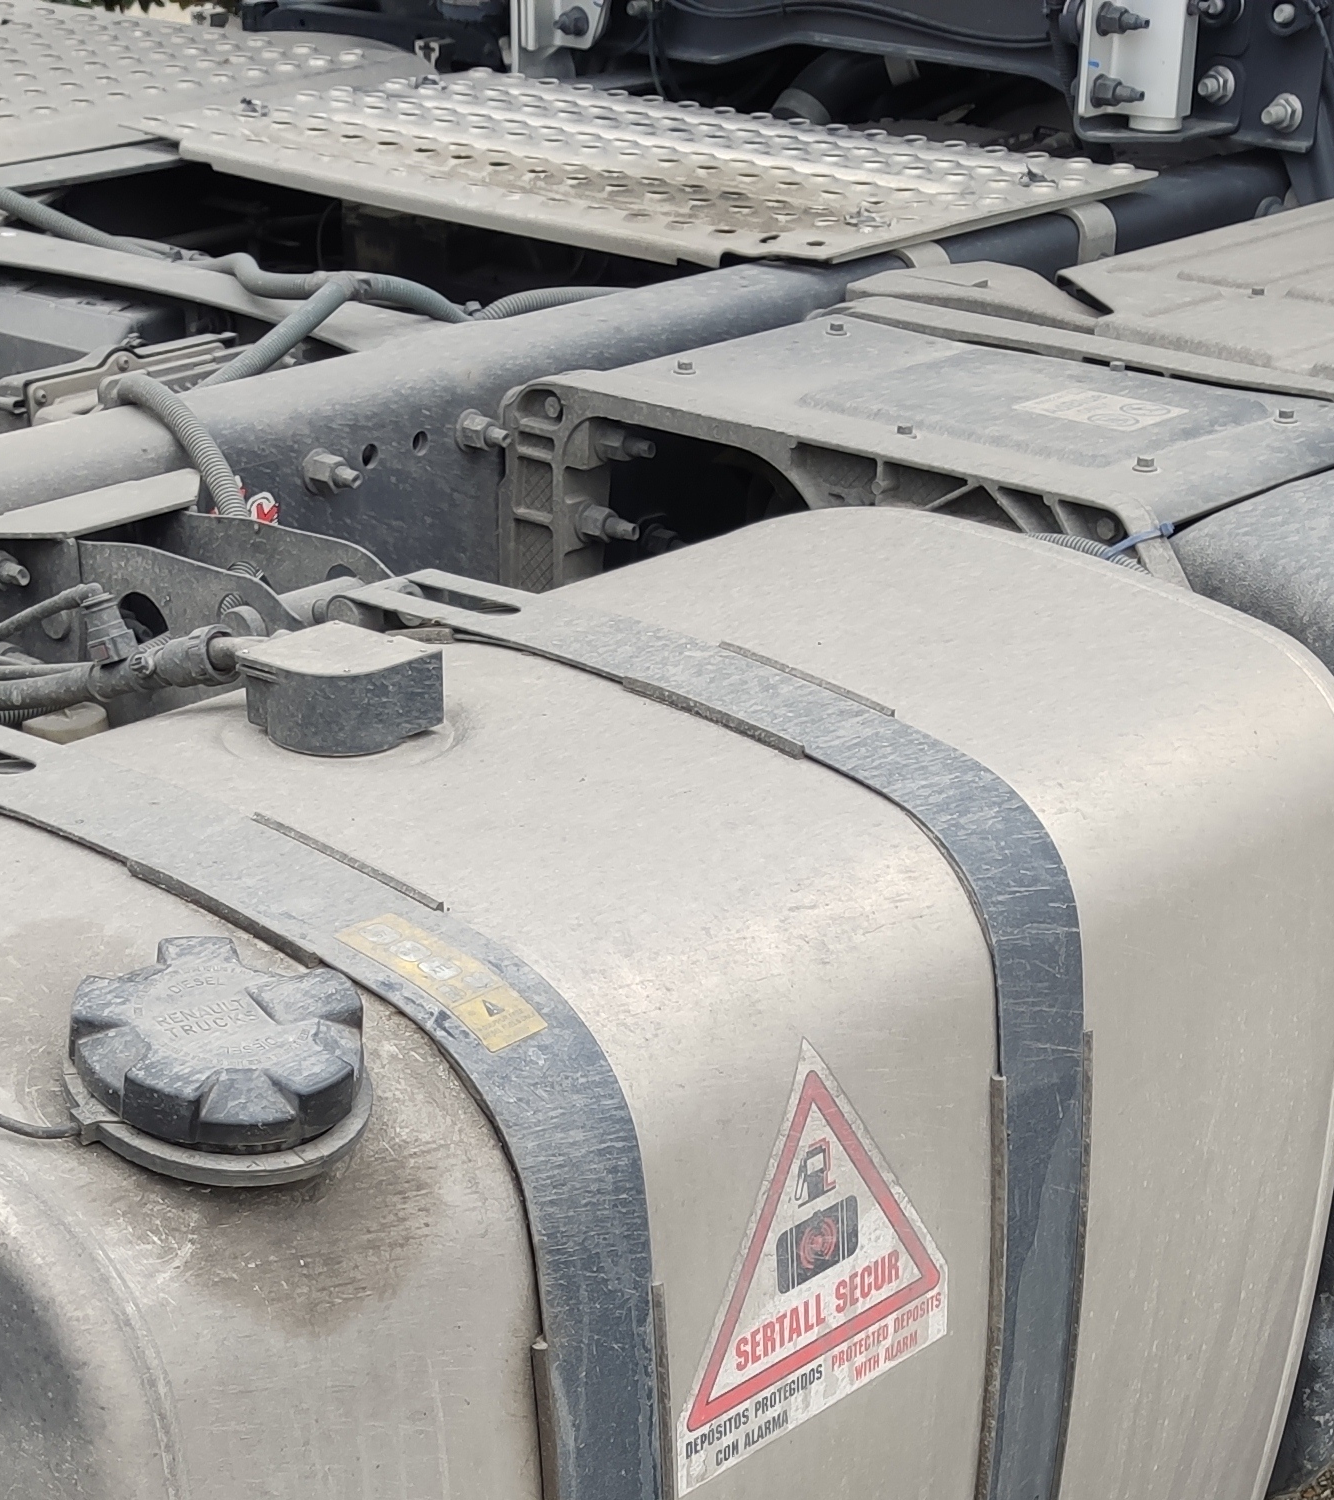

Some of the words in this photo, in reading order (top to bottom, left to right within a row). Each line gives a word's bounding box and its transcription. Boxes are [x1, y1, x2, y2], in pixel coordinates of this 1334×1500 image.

[168, 976, 226, 994] DIESEL
[152, 999, 247, 1027] RENAULT
[164, 1010, 259, 1039] TRUCKS
[219, 1037, 278, 1055] DIESEL
[735, 1293, 826, 1371] SERTALL
[834, 1249, 900, 1314] SECUR
[831, 1323, 889, 1372] PROTECTED
[893, 1292, 942, 1334] DEPOSITS
[854, 1354, 880, 1382] WITH
[883, 1330, 918, 1365] ALARM
[685, 1408, 750, 1460] DEPÓSITOS
[754, 1363, 823, 1419] PROTEGIDOS
[715, 1438, 740, 1467] CON
[743, 1408, 789, 1450] ALARMA
